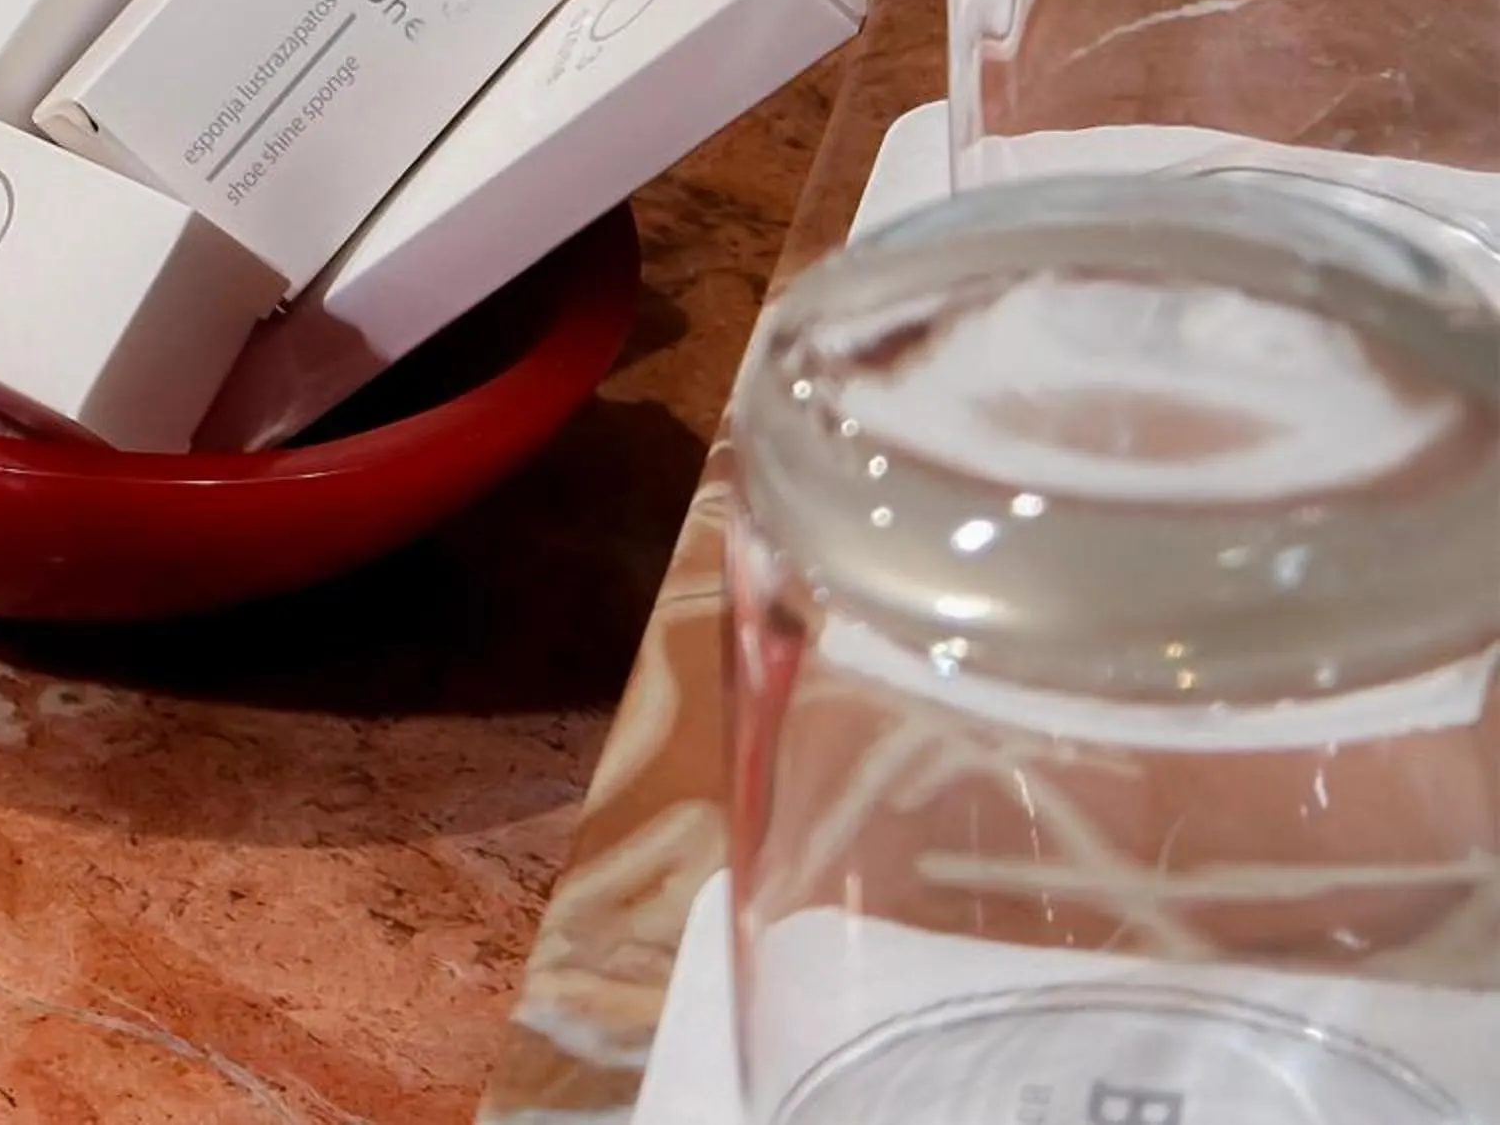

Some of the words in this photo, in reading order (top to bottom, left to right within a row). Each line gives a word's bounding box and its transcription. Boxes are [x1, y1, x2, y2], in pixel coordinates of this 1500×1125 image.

[184, 97, 246, 164] esponja
[227, 160, 268, 206] shoe
[262, 116, 307, 165] shine
[301, 55, 361, 122] sponge
